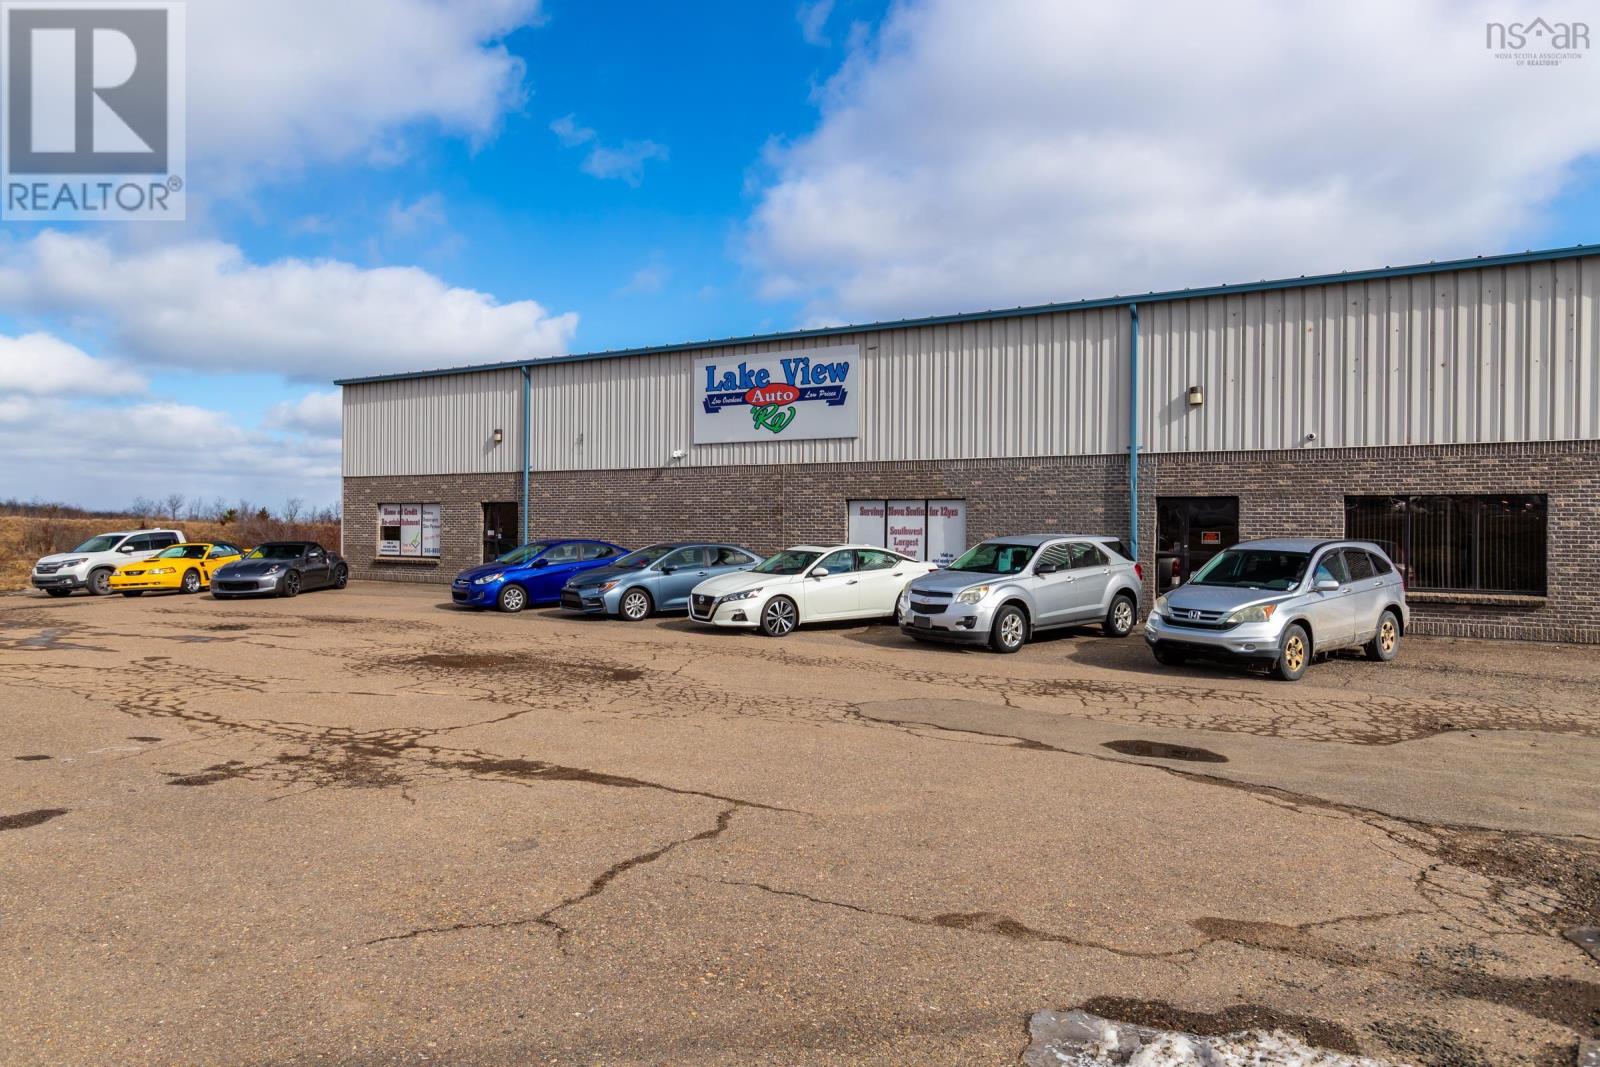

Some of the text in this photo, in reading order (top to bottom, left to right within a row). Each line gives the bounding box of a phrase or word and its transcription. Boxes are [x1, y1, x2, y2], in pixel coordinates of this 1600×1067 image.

[705, 357, 849, 392] Lake View
[751, 389, 794, 403] Auto
[805, 389, 837, 398] Low Prices
[750, 403, 796, 434] RV
[859, 506, 958, 518] Serving Nova Scotia for 12yrs
[889, 526, 923, 536] Southwest
[893, 537, 919, 548] Largest
